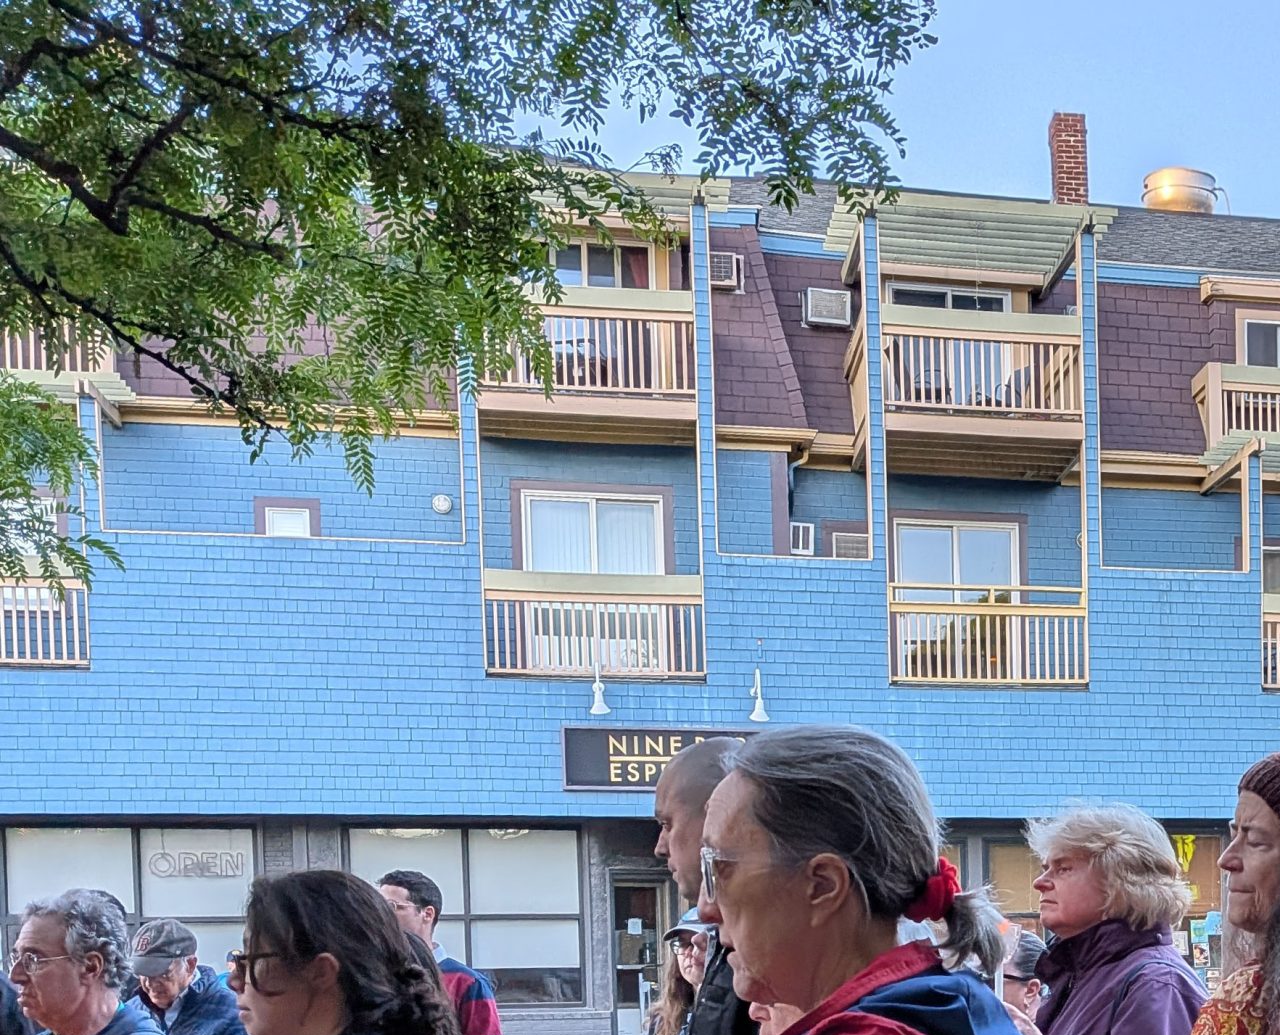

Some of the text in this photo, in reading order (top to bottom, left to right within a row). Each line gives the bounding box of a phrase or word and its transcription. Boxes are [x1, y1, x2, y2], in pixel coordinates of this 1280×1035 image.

[608, 734, 682, 756] NINE
[609, 762, 665, 783] ESP
[148, 851, 244, 878] OPEN
